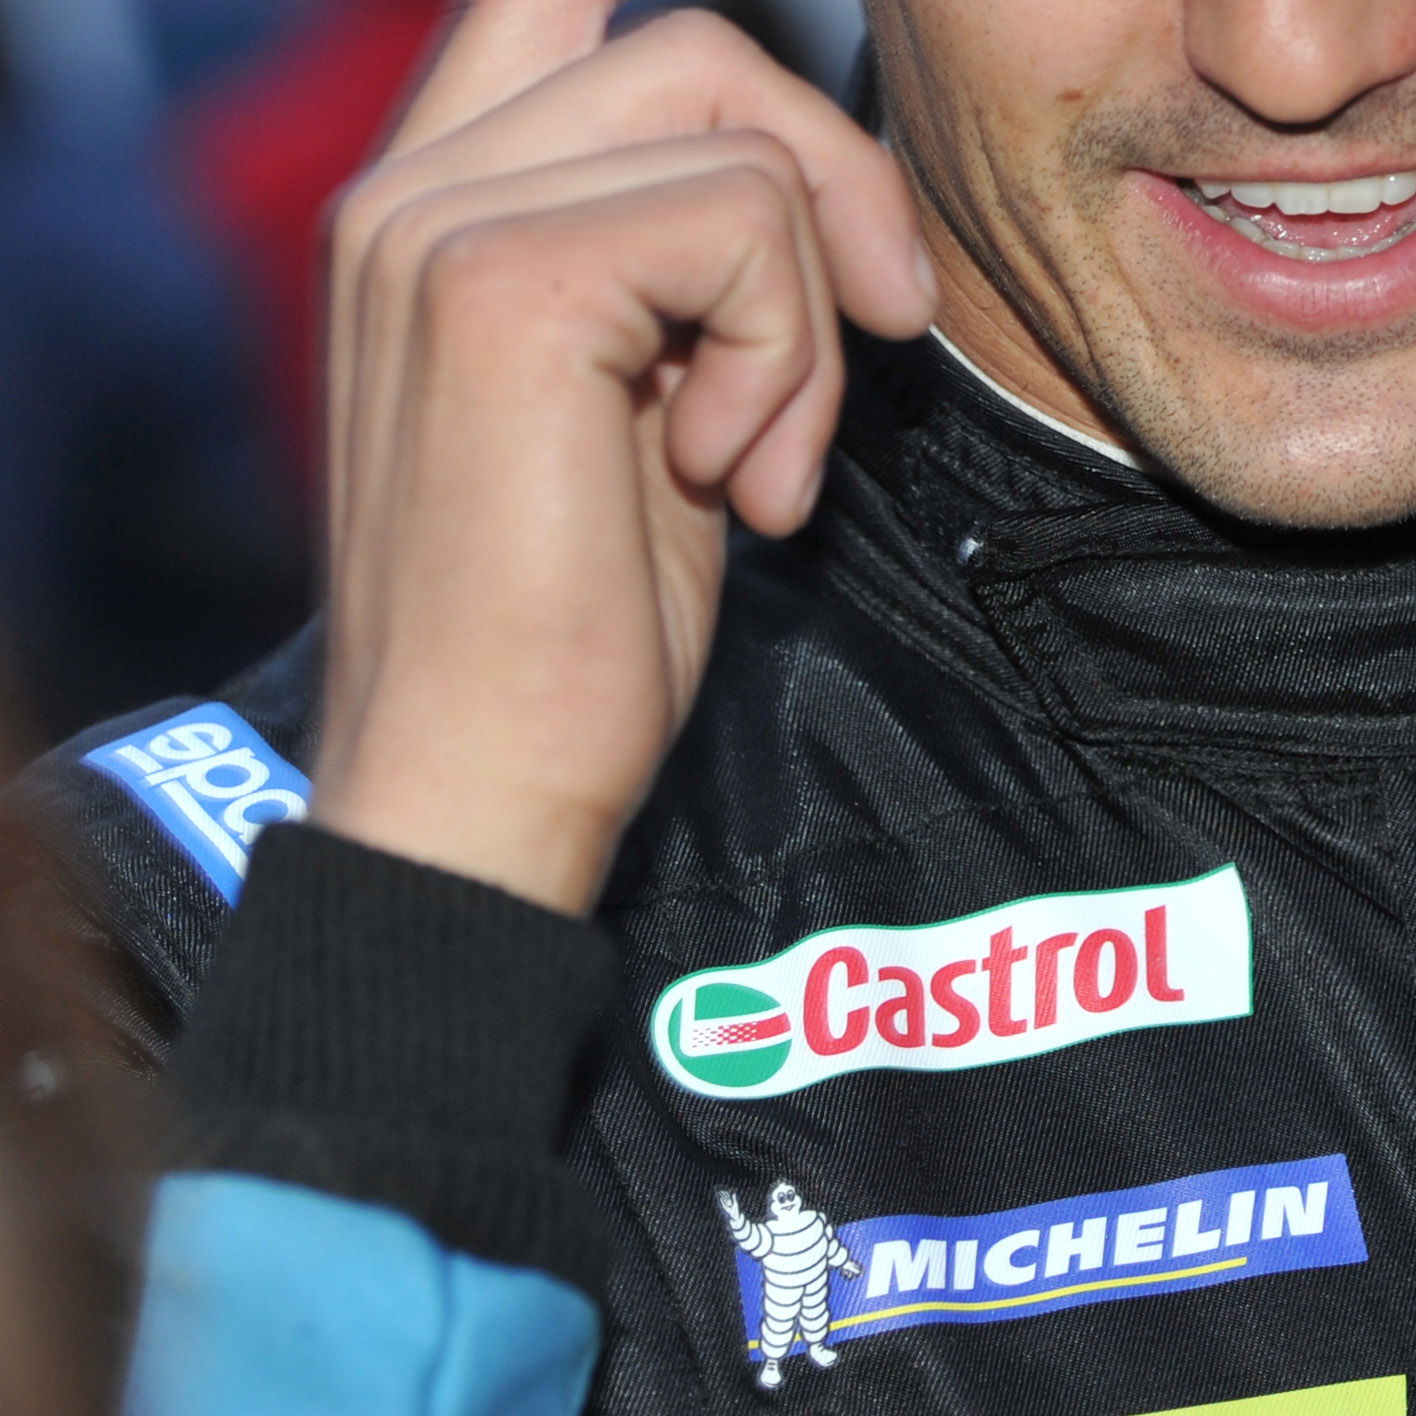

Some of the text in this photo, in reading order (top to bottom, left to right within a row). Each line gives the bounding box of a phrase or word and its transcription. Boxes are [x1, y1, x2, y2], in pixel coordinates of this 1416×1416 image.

[143, 721, 309, 847] spa
[801, 903, 1186, 1057] Castrol
[864, 1180, 1330, 1300] MICHELIN
